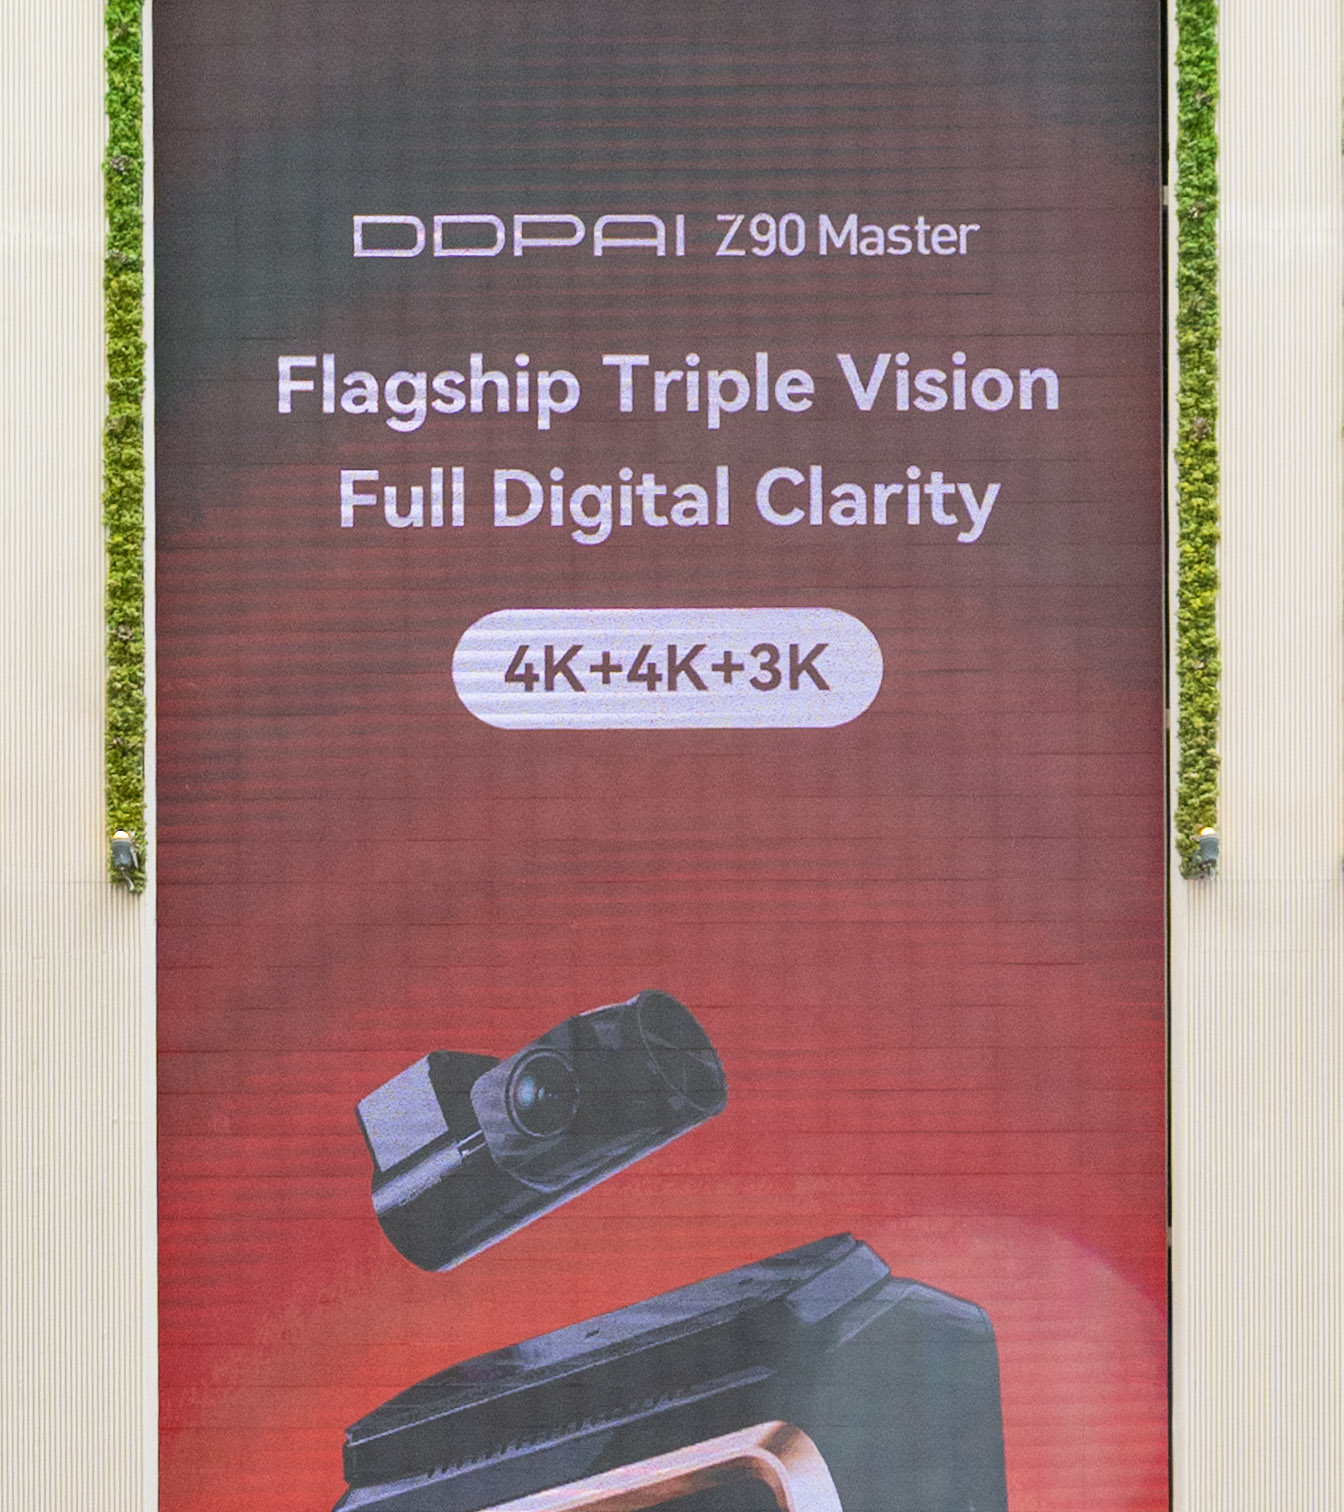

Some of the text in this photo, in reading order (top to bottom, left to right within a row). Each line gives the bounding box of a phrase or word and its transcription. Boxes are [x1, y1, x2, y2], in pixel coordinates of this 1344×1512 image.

[352, 213, 981, 257] DDPAI Z90 Master
[277, 352, 1060, 433] Flagship Triple Vision
[338, 465, 1002, 546] Full Digital Clarity
[503, 643, 831, 693] 4K+4K+3K
